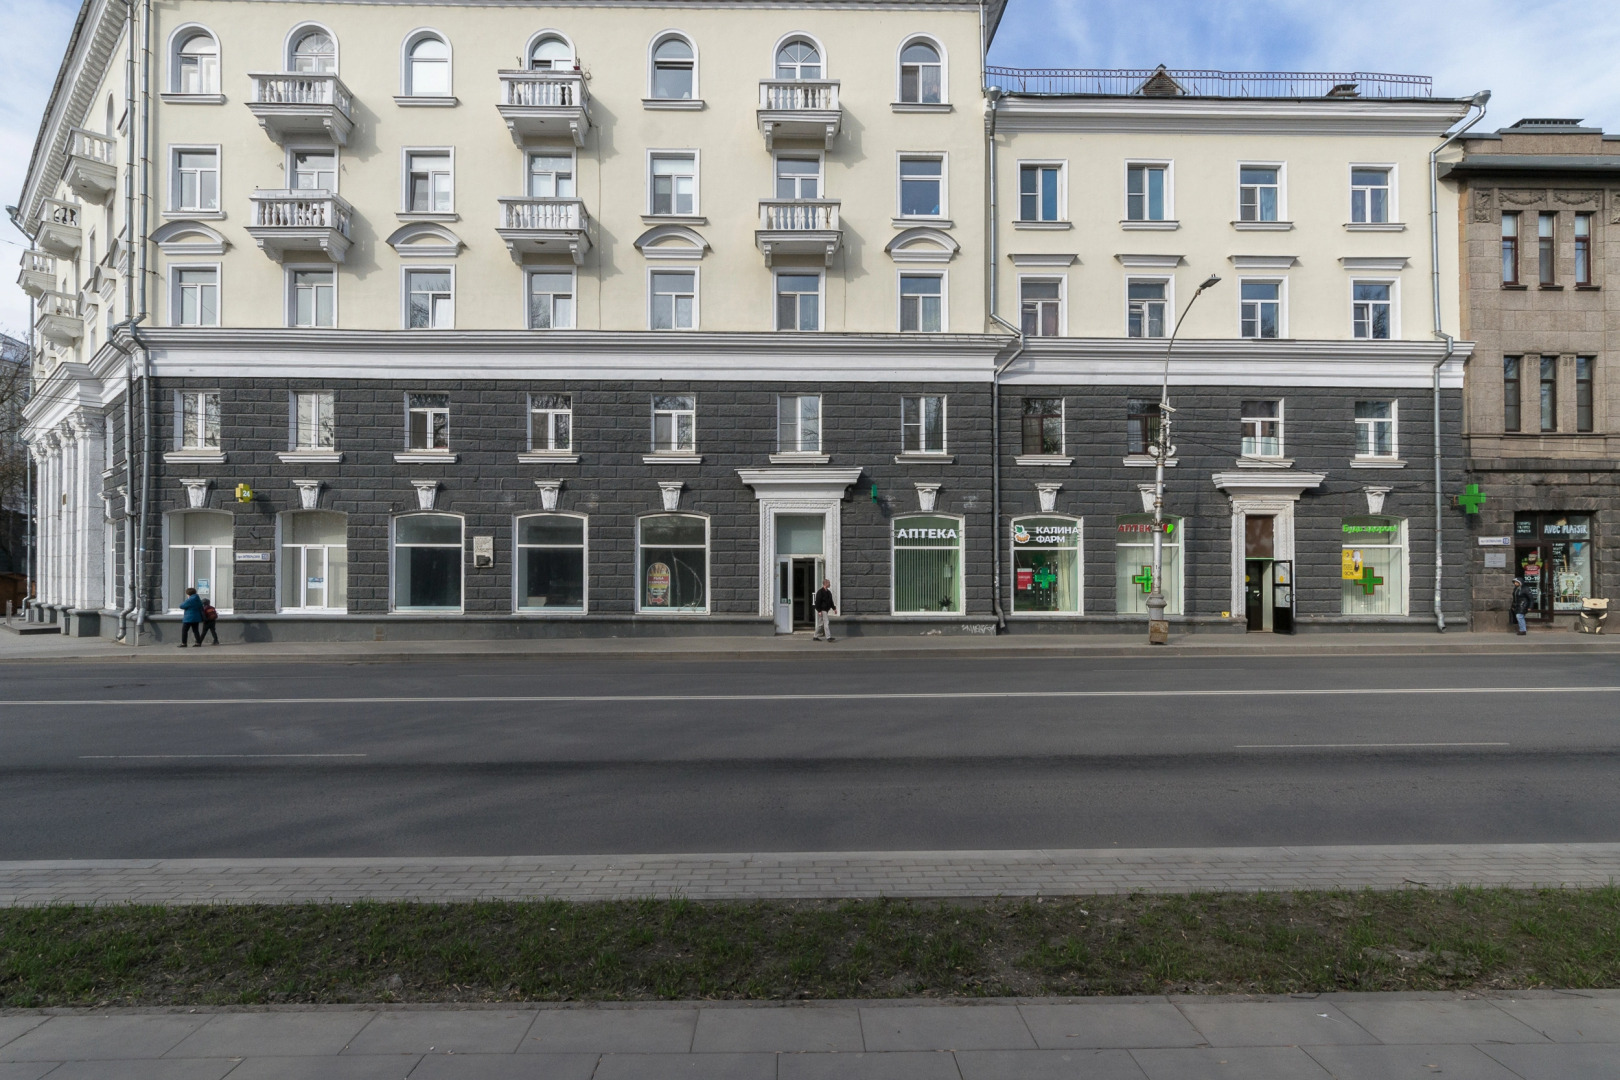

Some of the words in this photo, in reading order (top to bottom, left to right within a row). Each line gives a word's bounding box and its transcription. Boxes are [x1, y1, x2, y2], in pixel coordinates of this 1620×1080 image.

[1036, 526, 1079, 534] КАЛИНА
[1117, 523, 1152, 532] АПТЕК
[897, 528, 957, 539] АПТЕКА
[1036, 535, 1066, 543] ФАРМ
